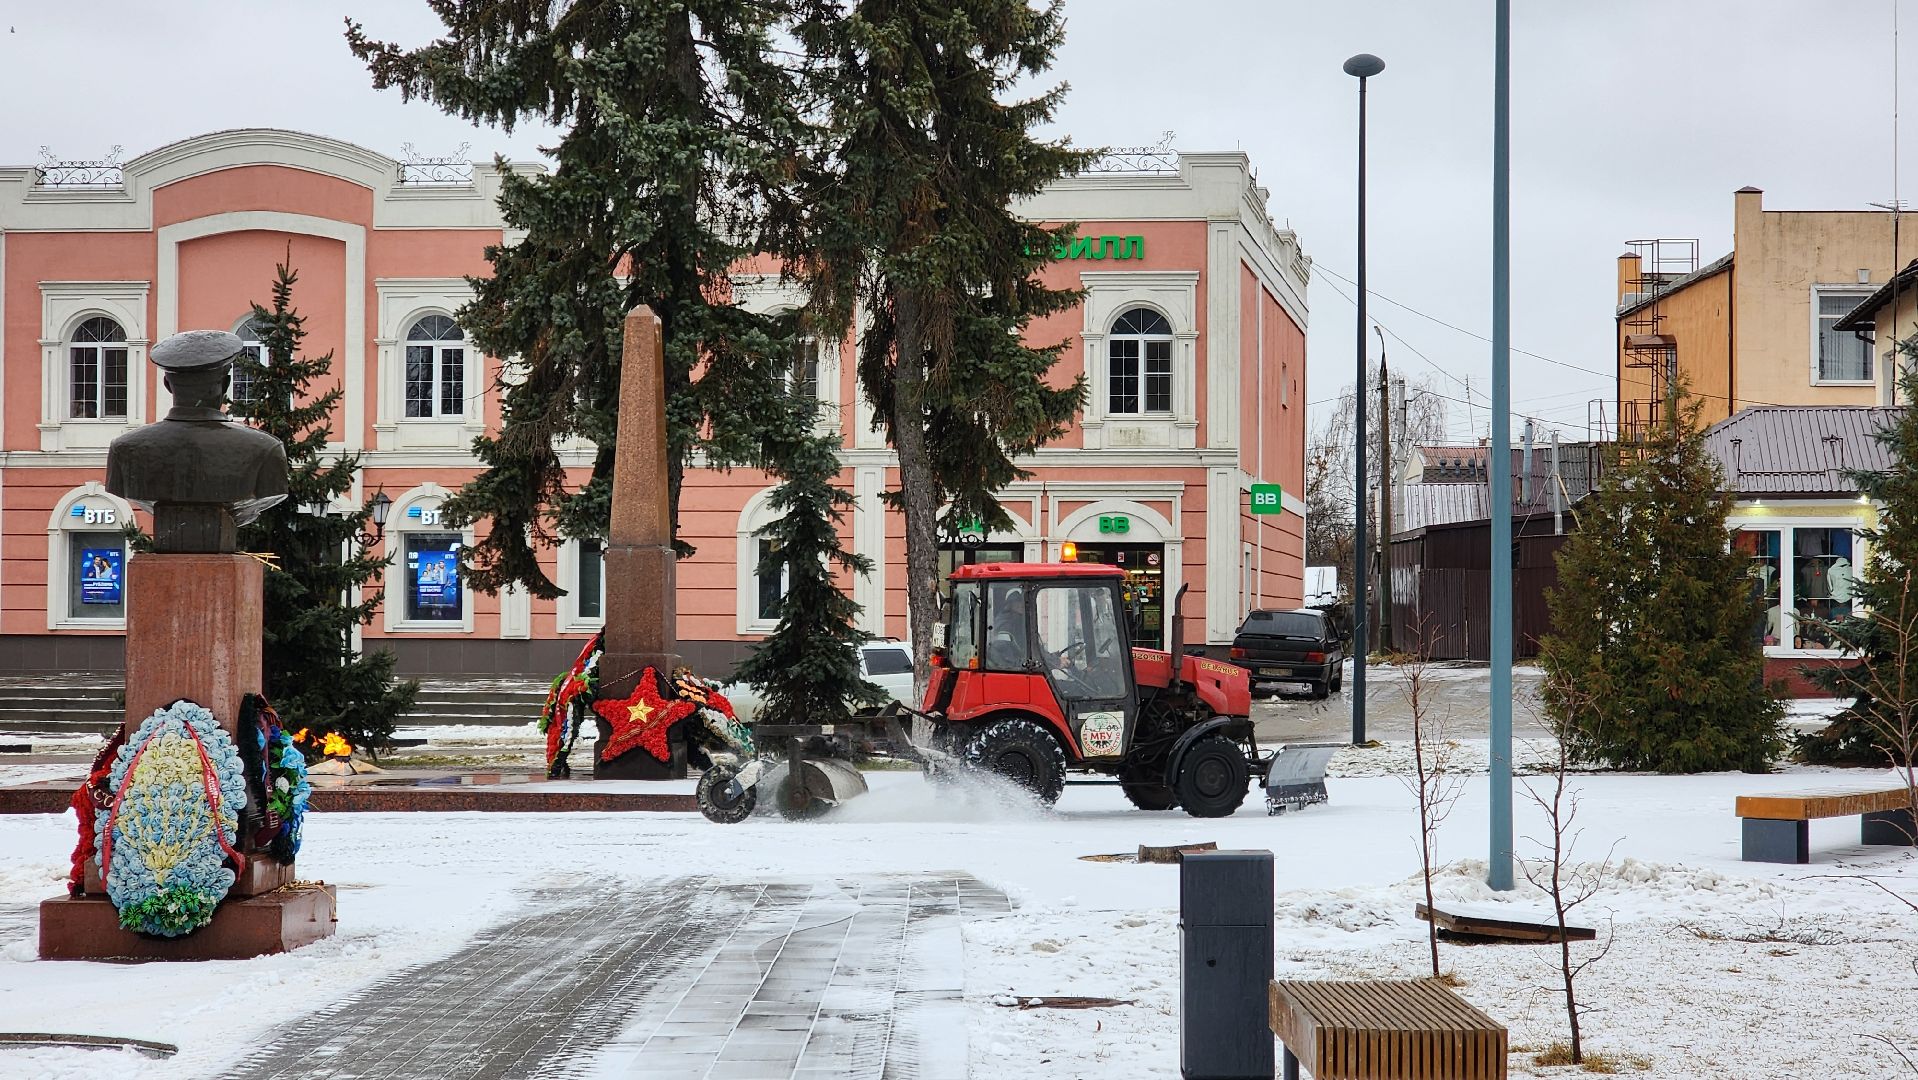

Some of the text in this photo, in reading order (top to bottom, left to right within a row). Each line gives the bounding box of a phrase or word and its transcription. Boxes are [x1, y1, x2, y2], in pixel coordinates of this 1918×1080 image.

[84, 509, 116, 524] ВТБ
[421, 510, 449, 525] ВТ
[1201, 661, 1239, 677] BELARUS
[1090, 731, 1113, 741] МБУ
